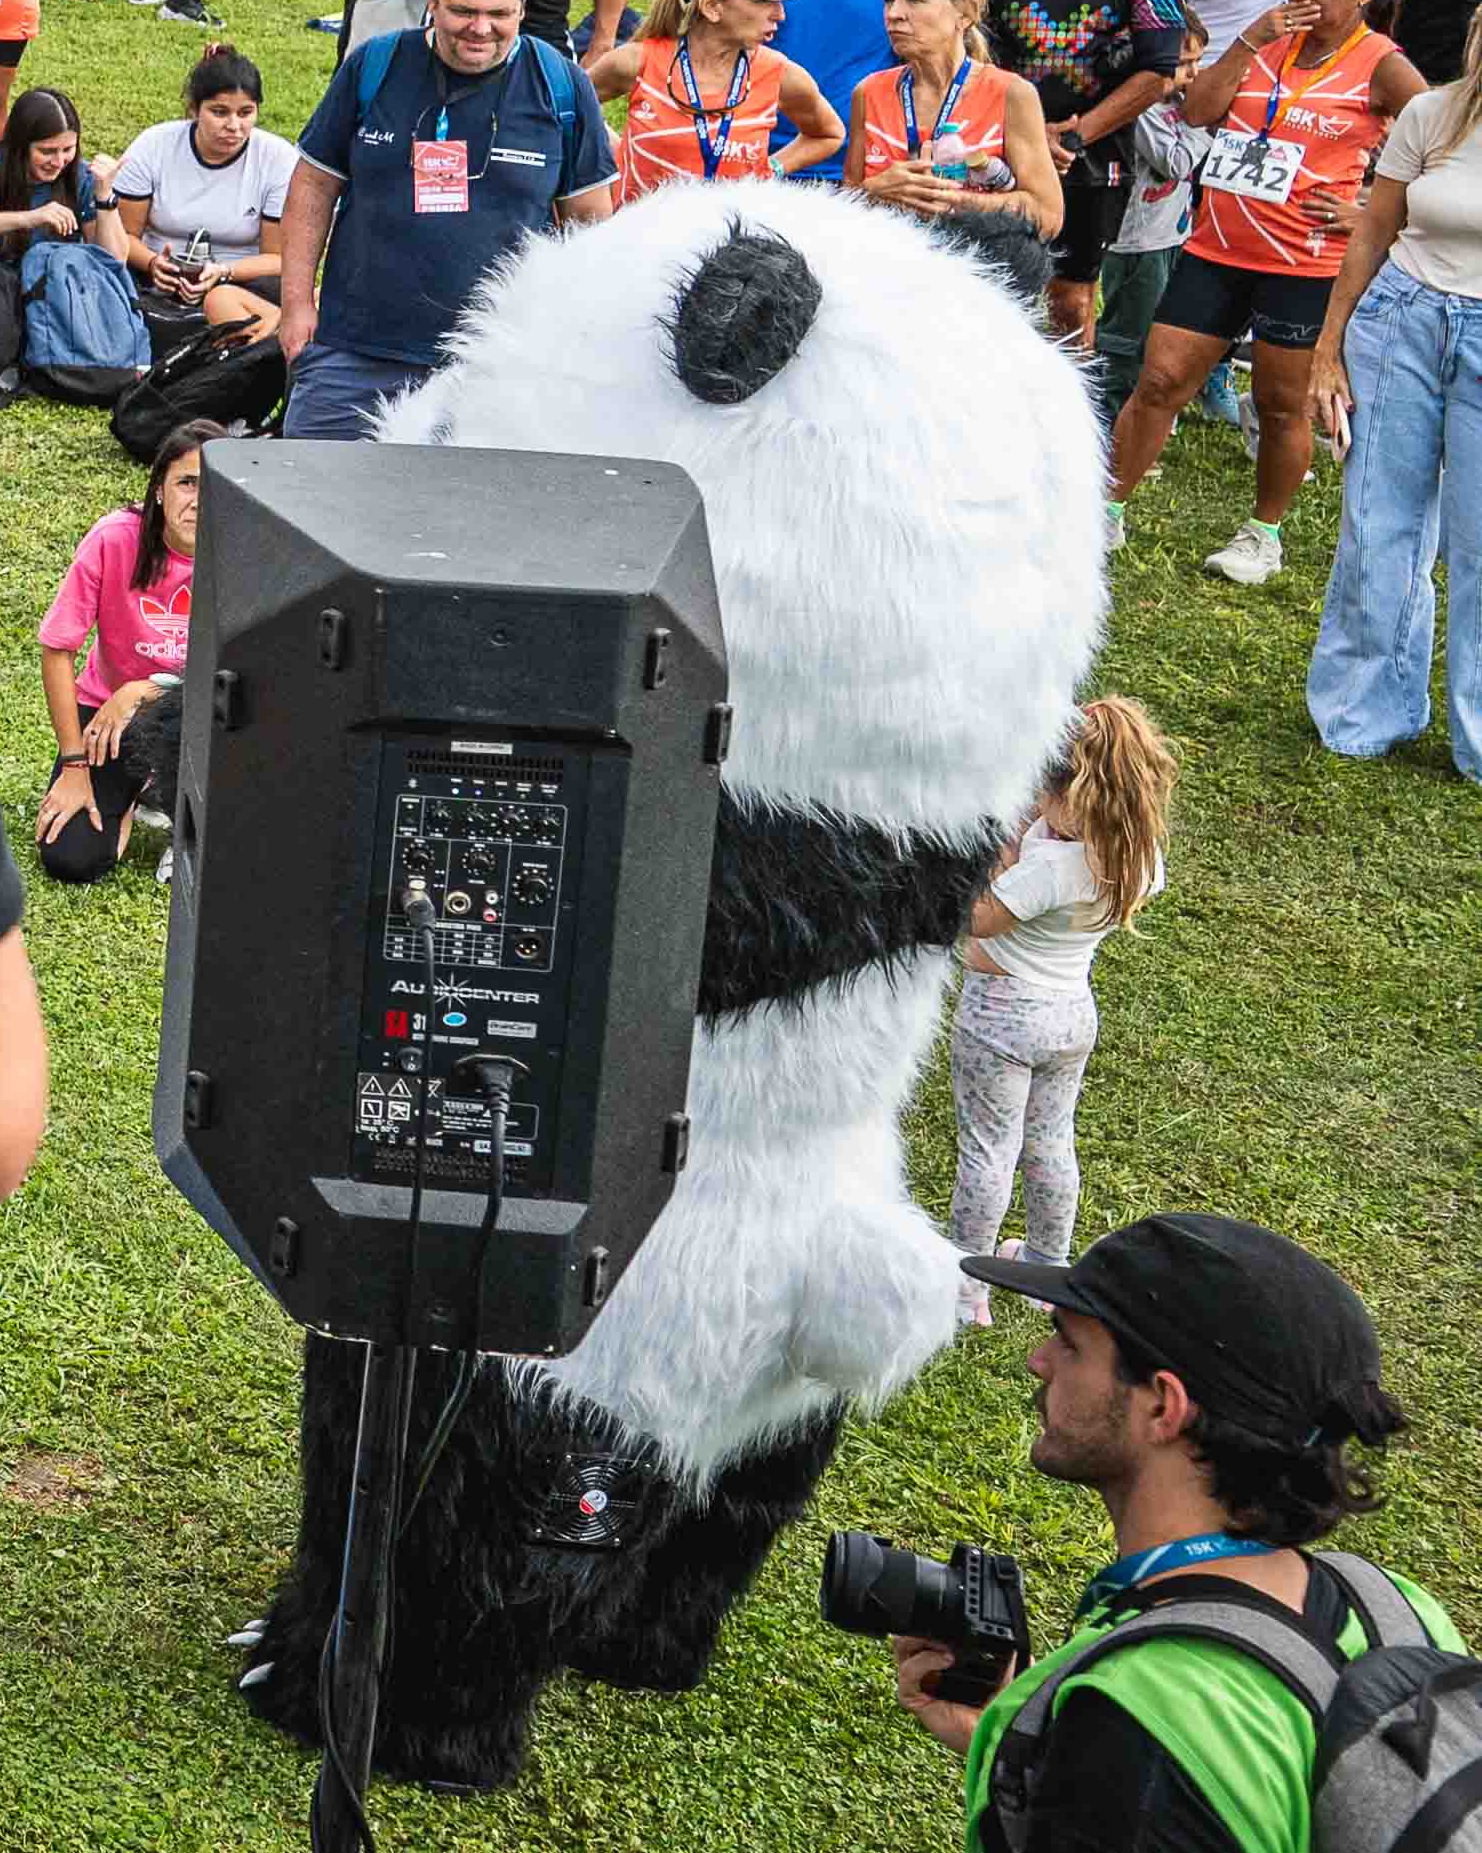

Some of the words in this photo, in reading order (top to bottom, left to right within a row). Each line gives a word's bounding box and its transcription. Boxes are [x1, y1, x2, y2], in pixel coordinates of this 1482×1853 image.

[1283, 105, 1317, 127] 15K
[1223, 137, 1244, 153] 15K
[1205, 154, 1289, 194] 1742
